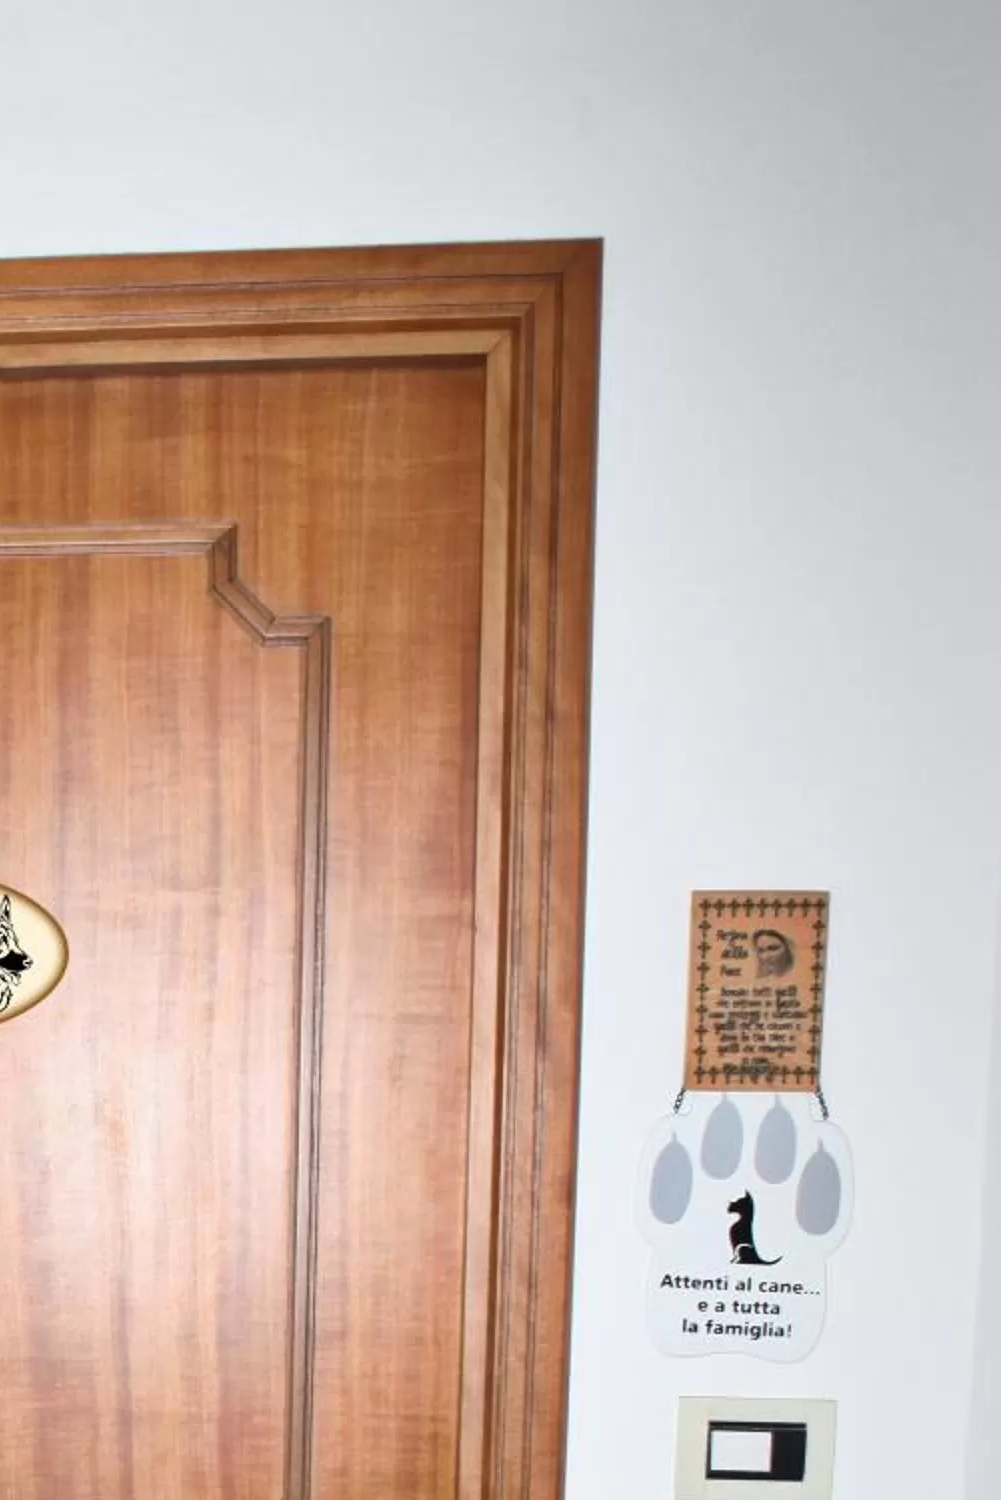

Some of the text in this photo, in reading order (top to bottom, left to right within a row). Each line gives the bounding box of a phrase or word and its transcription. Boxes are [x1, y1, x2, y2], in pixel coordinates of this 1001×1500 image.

[660, 1273, 821, 1296] Attenti al cane...
[697, 1300, 781, 1315] e a tutta
[682, 1319, 792, 1341] la famiglia!
